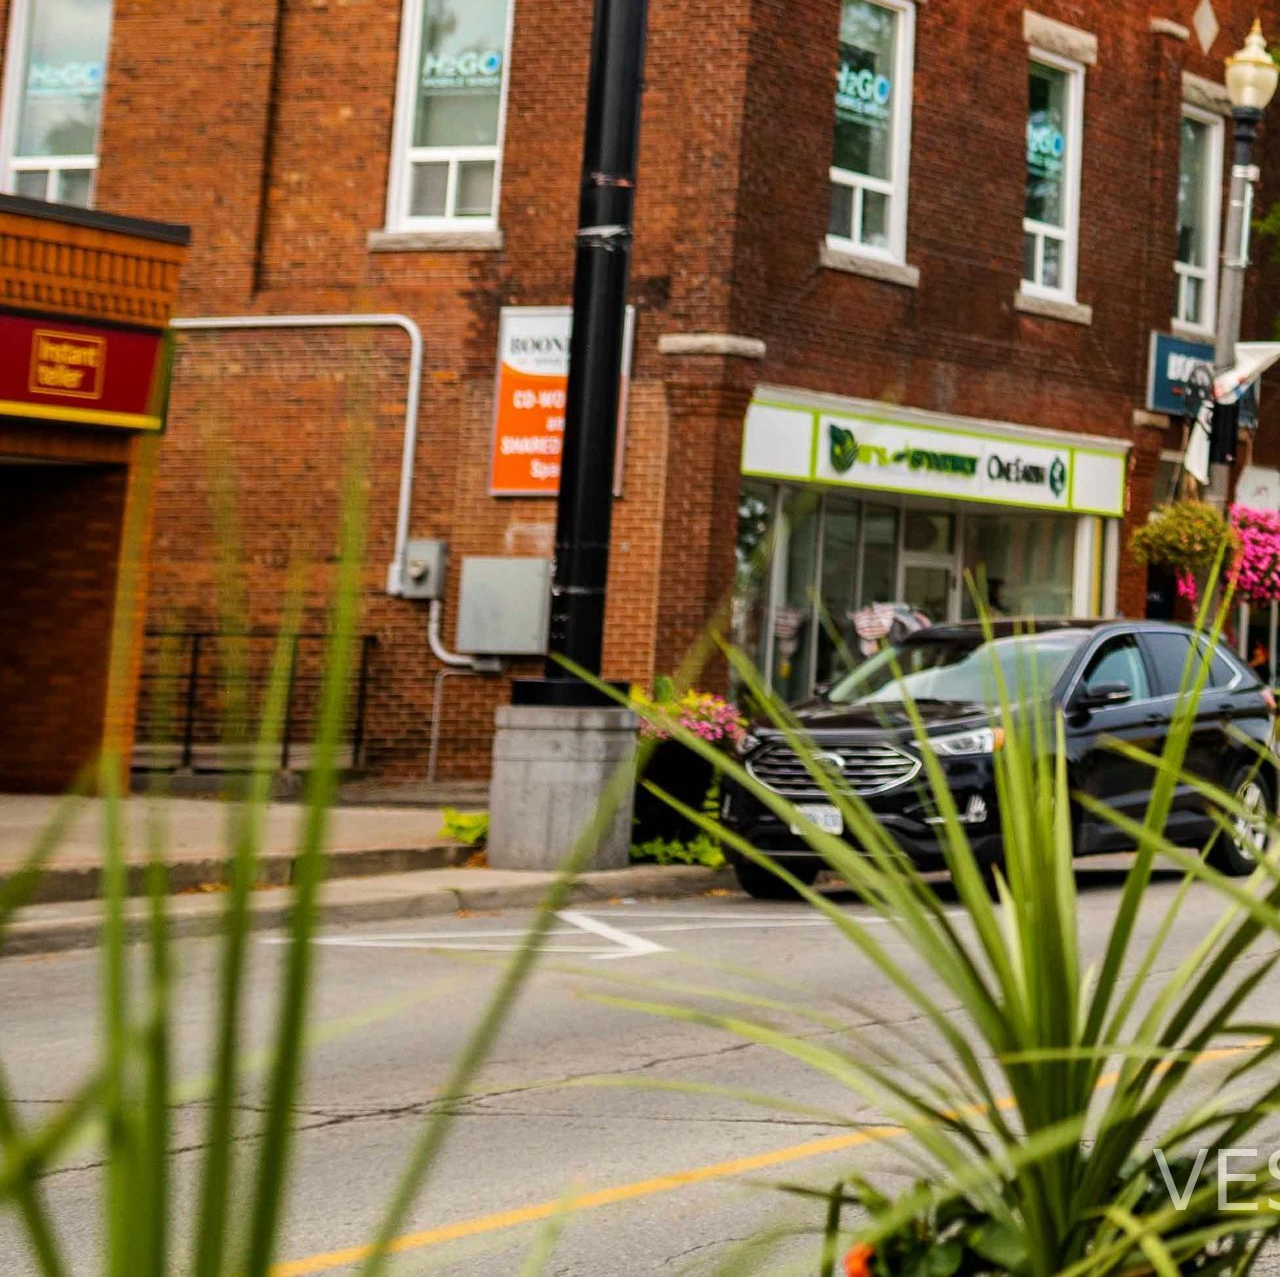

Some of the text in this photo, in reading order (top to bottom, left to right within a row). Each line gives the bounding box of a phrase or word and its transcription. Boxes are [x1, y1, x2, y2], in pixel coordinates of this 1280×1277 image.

[424, 51, 503, 76] H2GO
[510, 337, 571, 355] BOON
[513, 390, 567, 409] CO-WO
